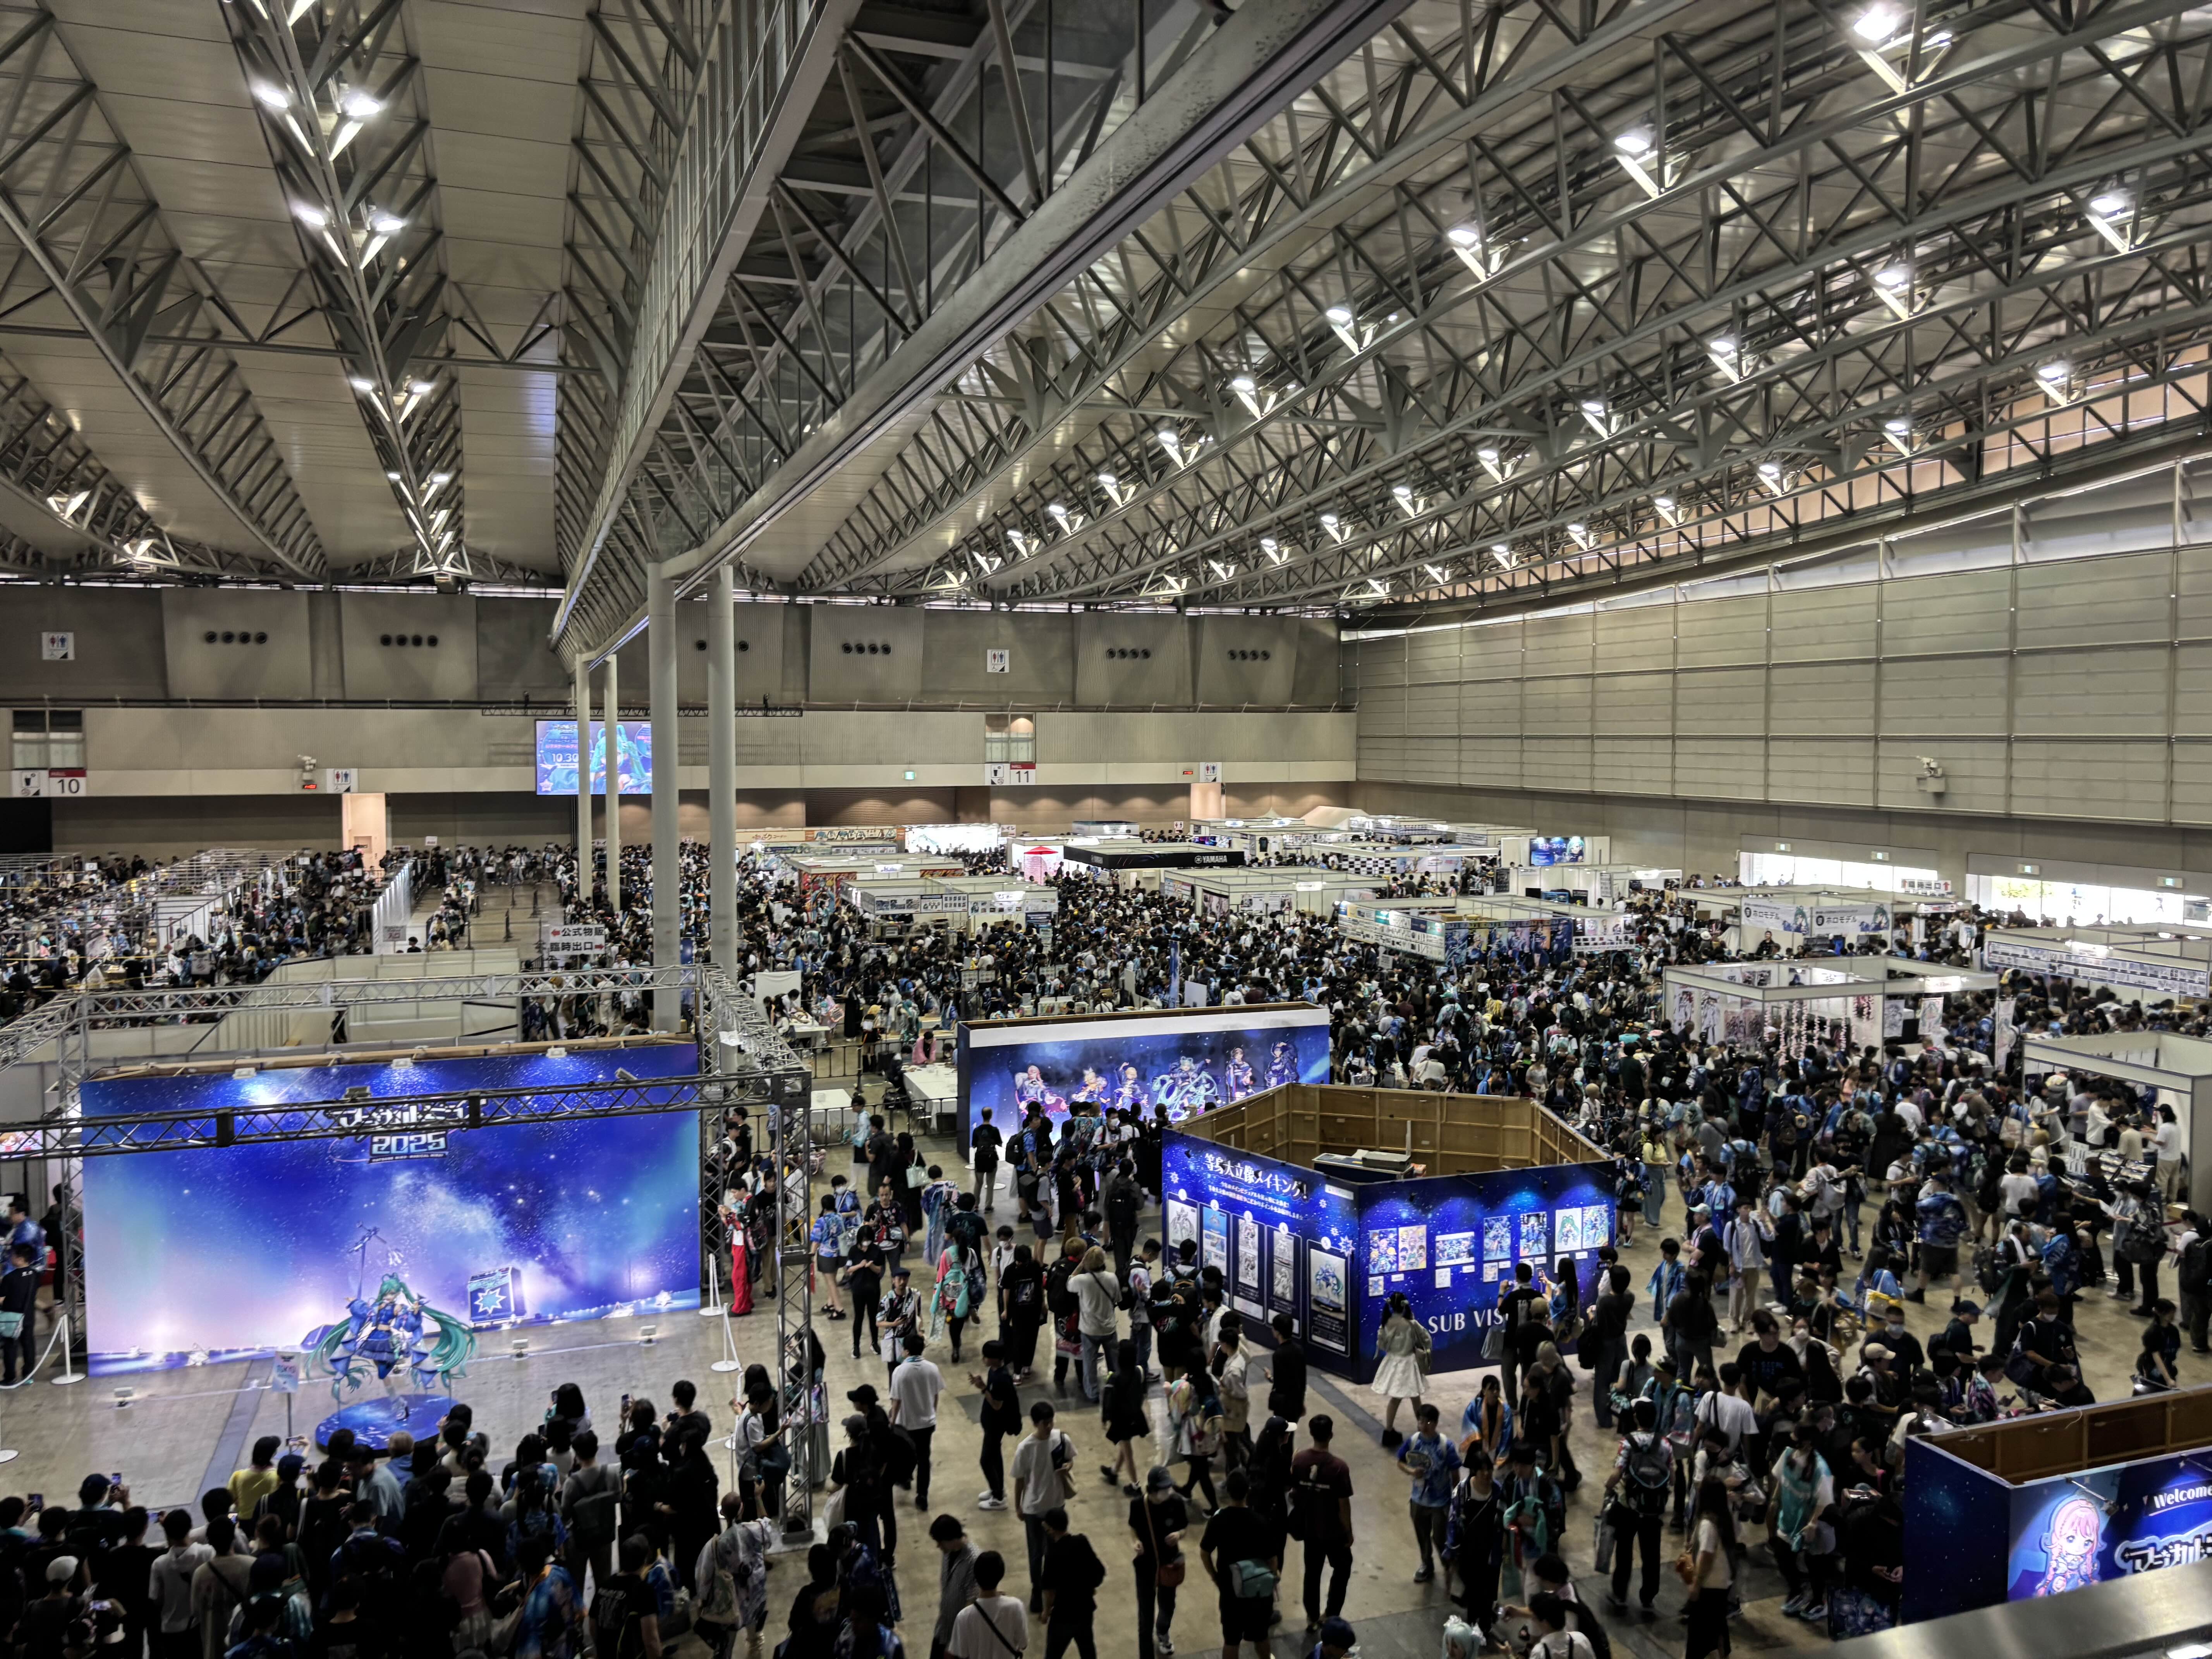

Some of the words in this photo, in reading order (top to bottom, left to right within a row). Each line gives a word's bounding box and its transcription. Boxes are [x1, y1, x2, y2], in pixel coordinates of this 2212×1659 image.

[1016, 770, 1029, 783] 11
[57, 778, 81, 794] 10
[1202, 855, 1228, 863] YAMAHA
[1753, 910, 1779, 920] ホロモデル
[1826, 915, 1856, 924] ホロモデル
[372, 1131, 447, 1155] 2025
[1428, 1312, 1465, 1334] SUB
